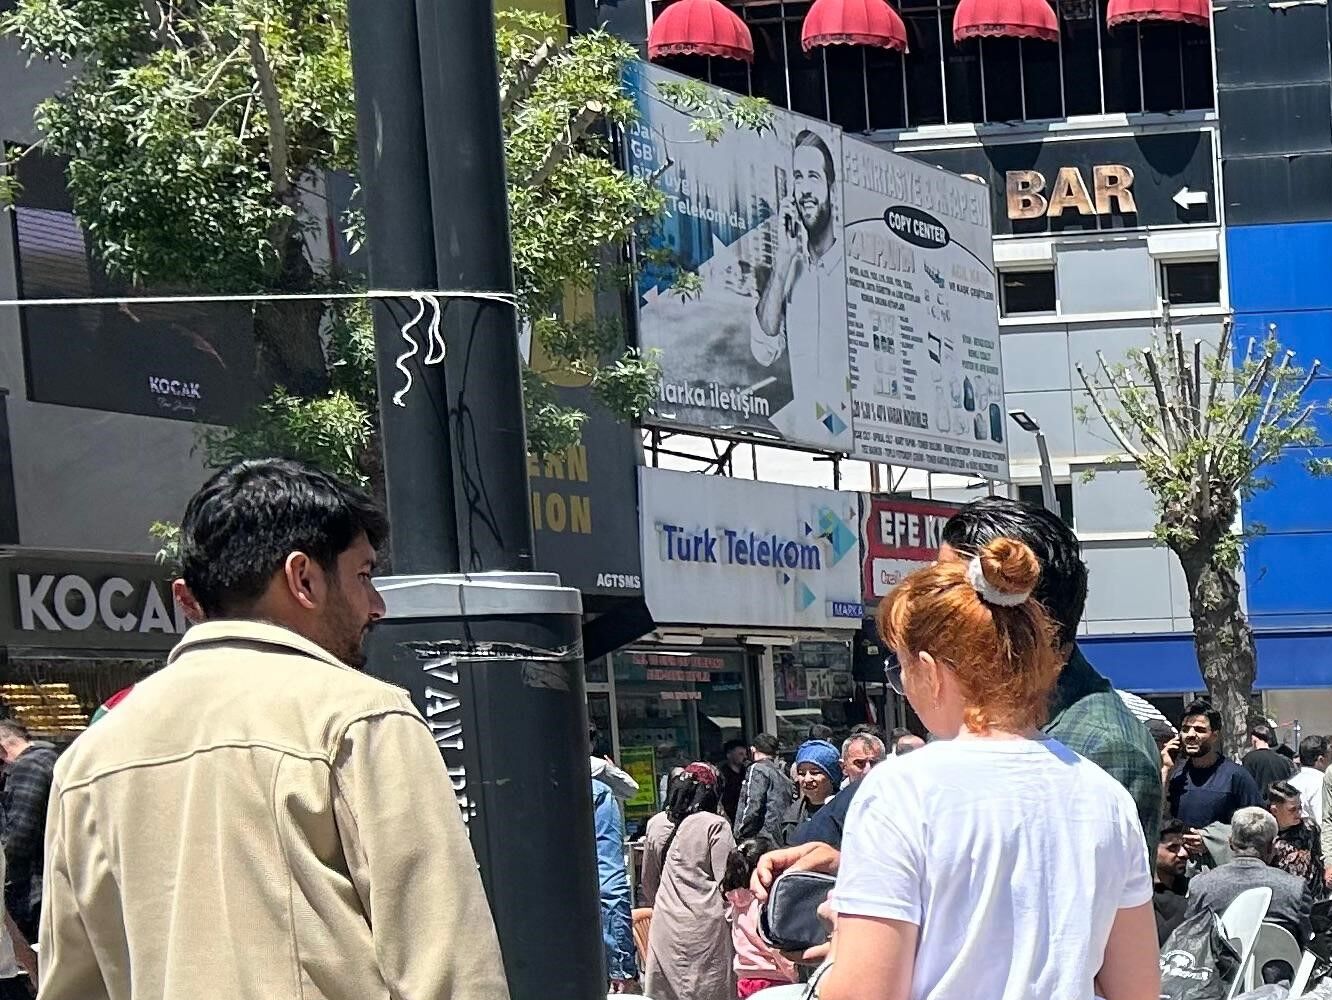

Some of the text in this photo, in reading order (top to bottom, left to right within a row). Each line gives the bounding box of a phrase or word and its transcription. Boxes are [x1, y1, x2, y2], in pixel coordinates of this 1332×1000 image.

[1006, 164, 1138, 220] BAR
[888, 211, 947, 244] COPY CENTER
[710, 382, 770, 420] iletişim
[663, 524, 821, 570] Türk Telekom
[880, 510, 920, 549] EFE
[596, 573, 641, 589] AGTSMS
